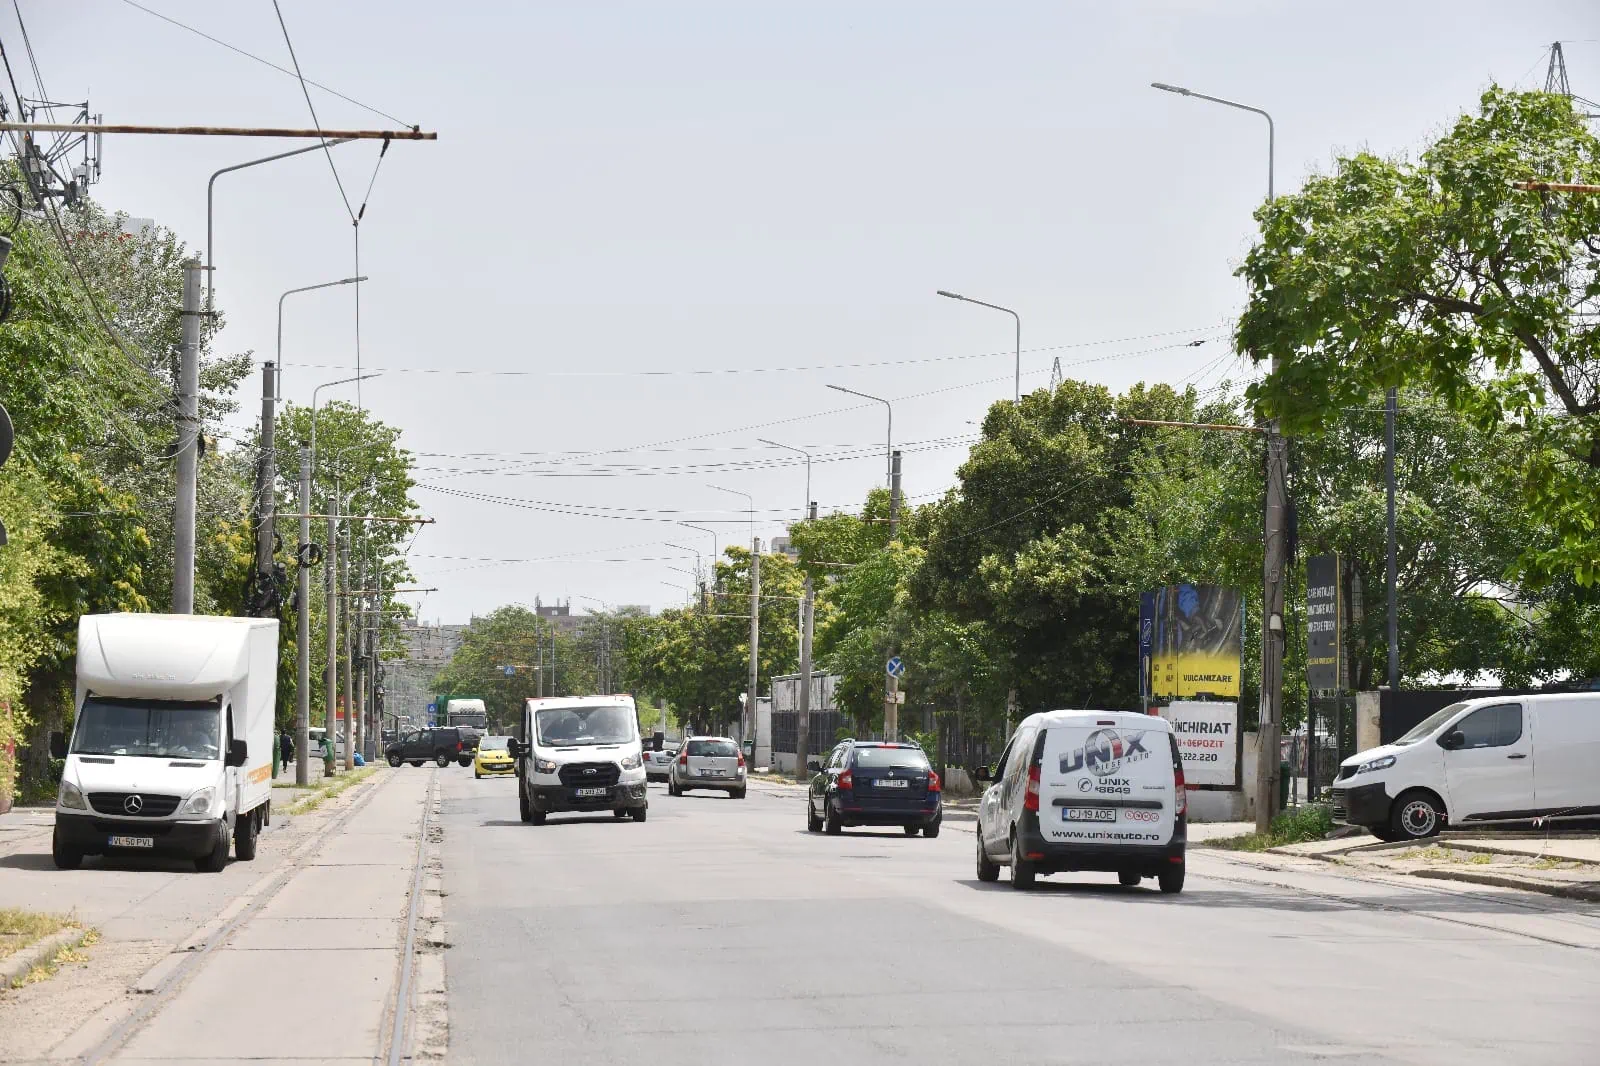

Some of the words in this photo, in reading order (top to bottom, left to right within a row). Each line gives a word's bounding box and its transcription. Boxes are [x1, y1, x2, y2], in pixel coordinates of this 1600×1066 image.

[1183, 674, 1233, 683] VULCANIZARE
[1187, 739, 1225, 748] DEPOZIT
[1126, 752, 1150, 764] AUTO
[1098, 778, 1131, 786] UNIX
[1052, 831, 1160, 841] www.unixauto.ro
